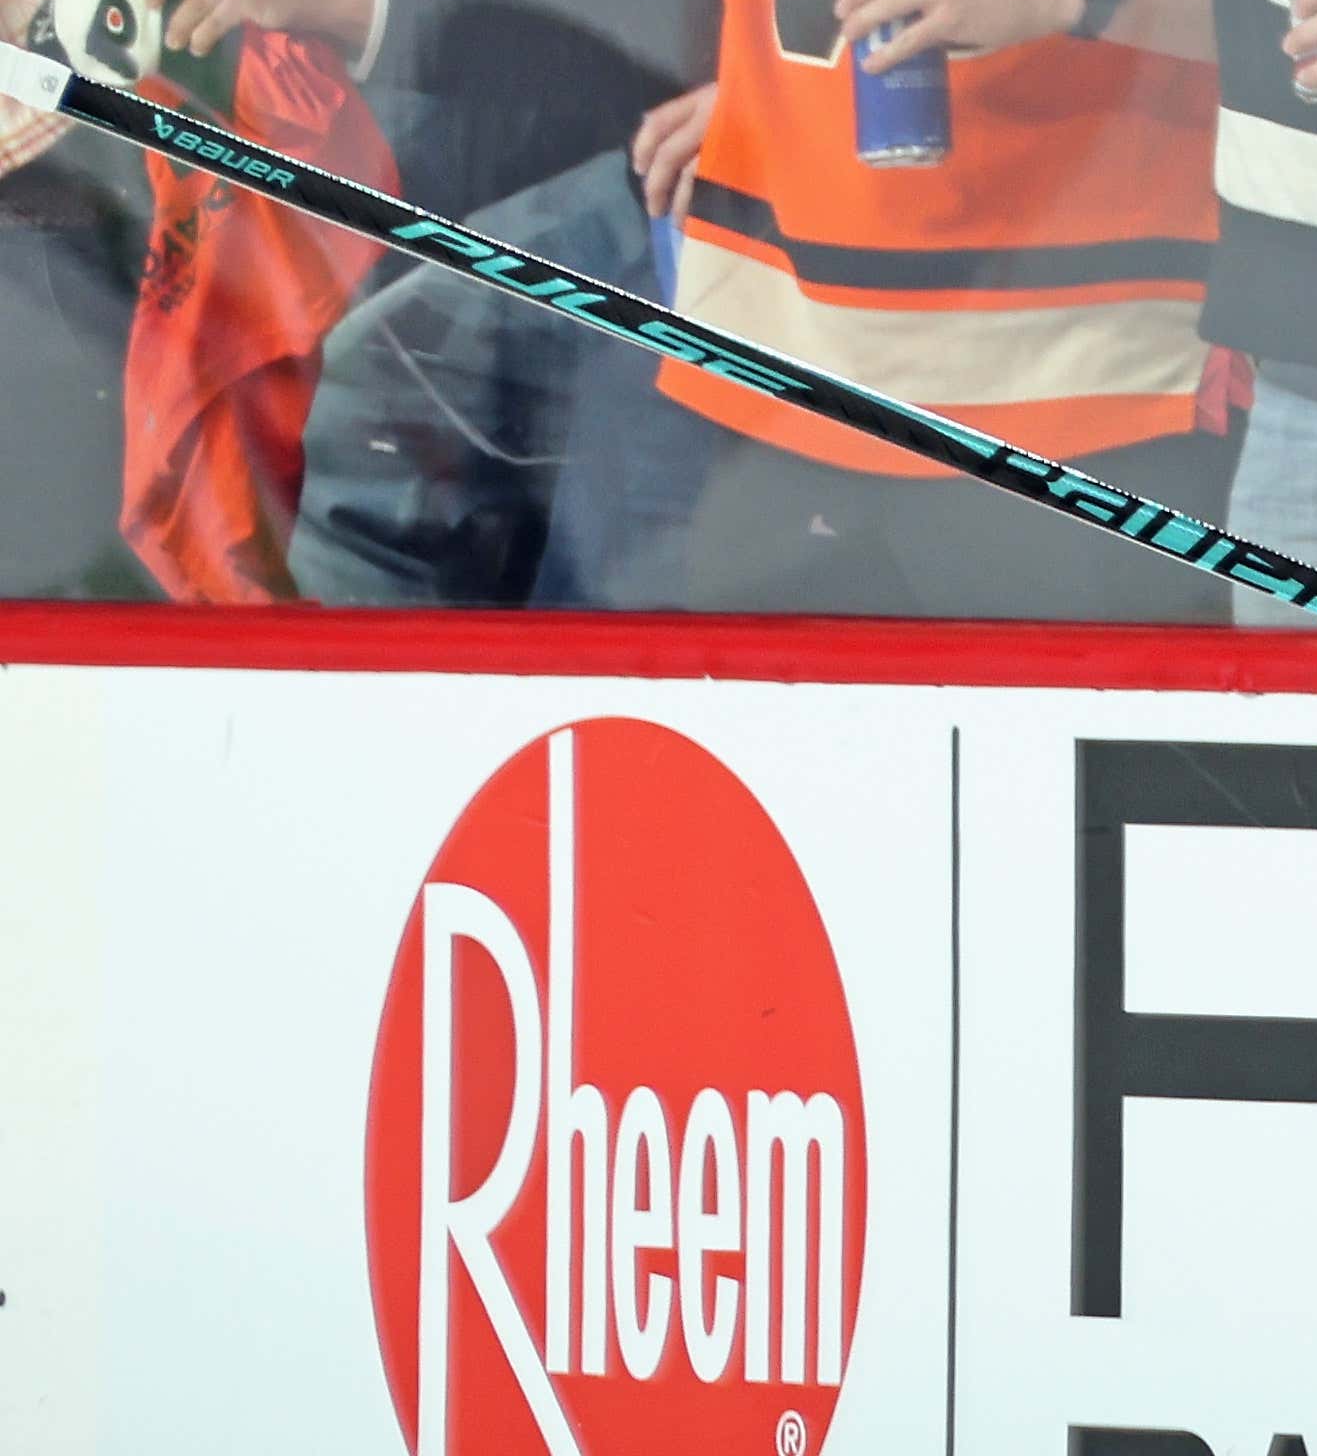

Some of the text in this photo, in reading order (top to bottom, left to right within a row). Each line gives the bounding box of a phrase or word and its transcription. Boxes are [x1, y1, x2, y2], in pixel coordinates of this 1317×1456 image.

[173, 130, 296, 189] BAUER
[391, 220, 814, 397] PULSE
[418, 727, 844, 1456] Rheem
